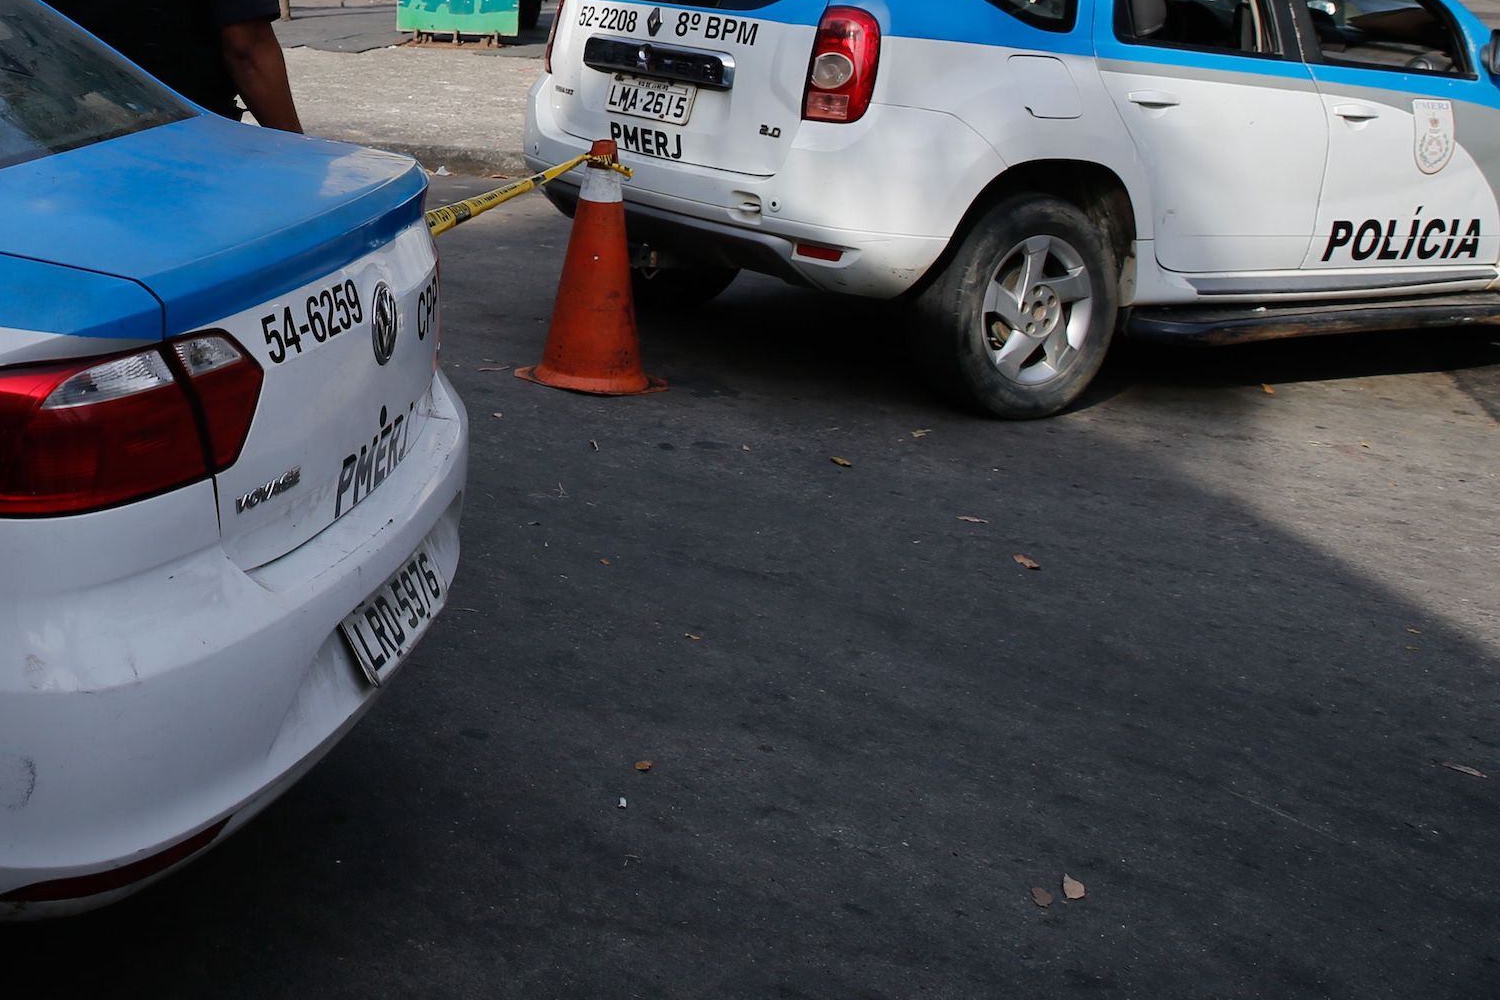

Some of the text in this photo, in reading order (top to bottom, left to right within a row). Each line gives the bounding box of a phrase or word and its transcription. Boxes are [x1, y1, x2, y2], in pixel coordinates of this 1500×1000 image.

[579, 6, 638, 33] 52-2208
[705, 16, 759, 46] BPM
[610, 121, 681, 160] PMERJ
[1321, 206, 1481, 262] POLÍCIA
[261, 279, 364, 364] 54-6259
[334, 402, 414, 519] PMERJ
[236, 465, 302, 514] VOYAGE
